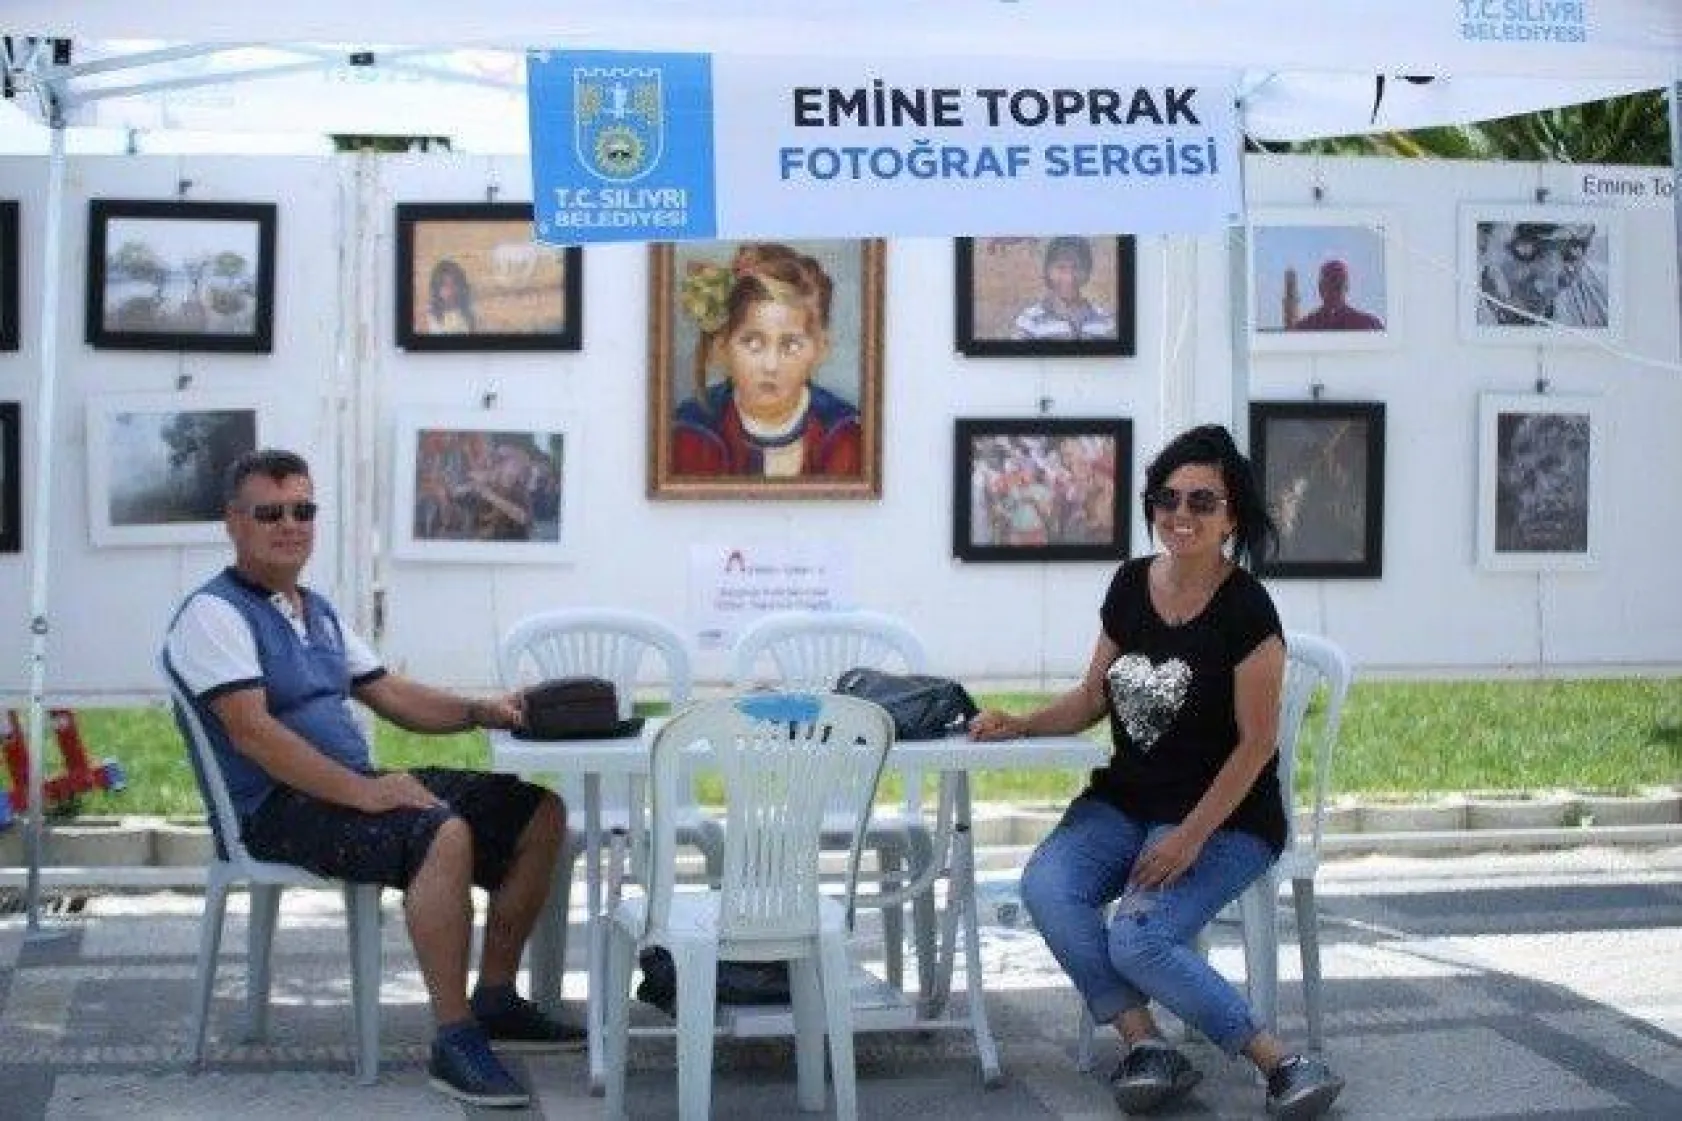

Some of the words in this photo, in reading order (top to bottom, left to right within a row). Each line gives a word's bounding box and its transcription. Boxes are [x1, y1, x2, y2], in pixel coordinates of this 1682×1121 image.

[794, 78, 963, 127] EMİNE
[976, 87, 1200, 127] TOPRAK
[779, 139, 1030, 180] FOTOĞRAF
[1044, 136, 1219, 177] SERGİSİ
[1582, 173, 1645, 196] Emine
